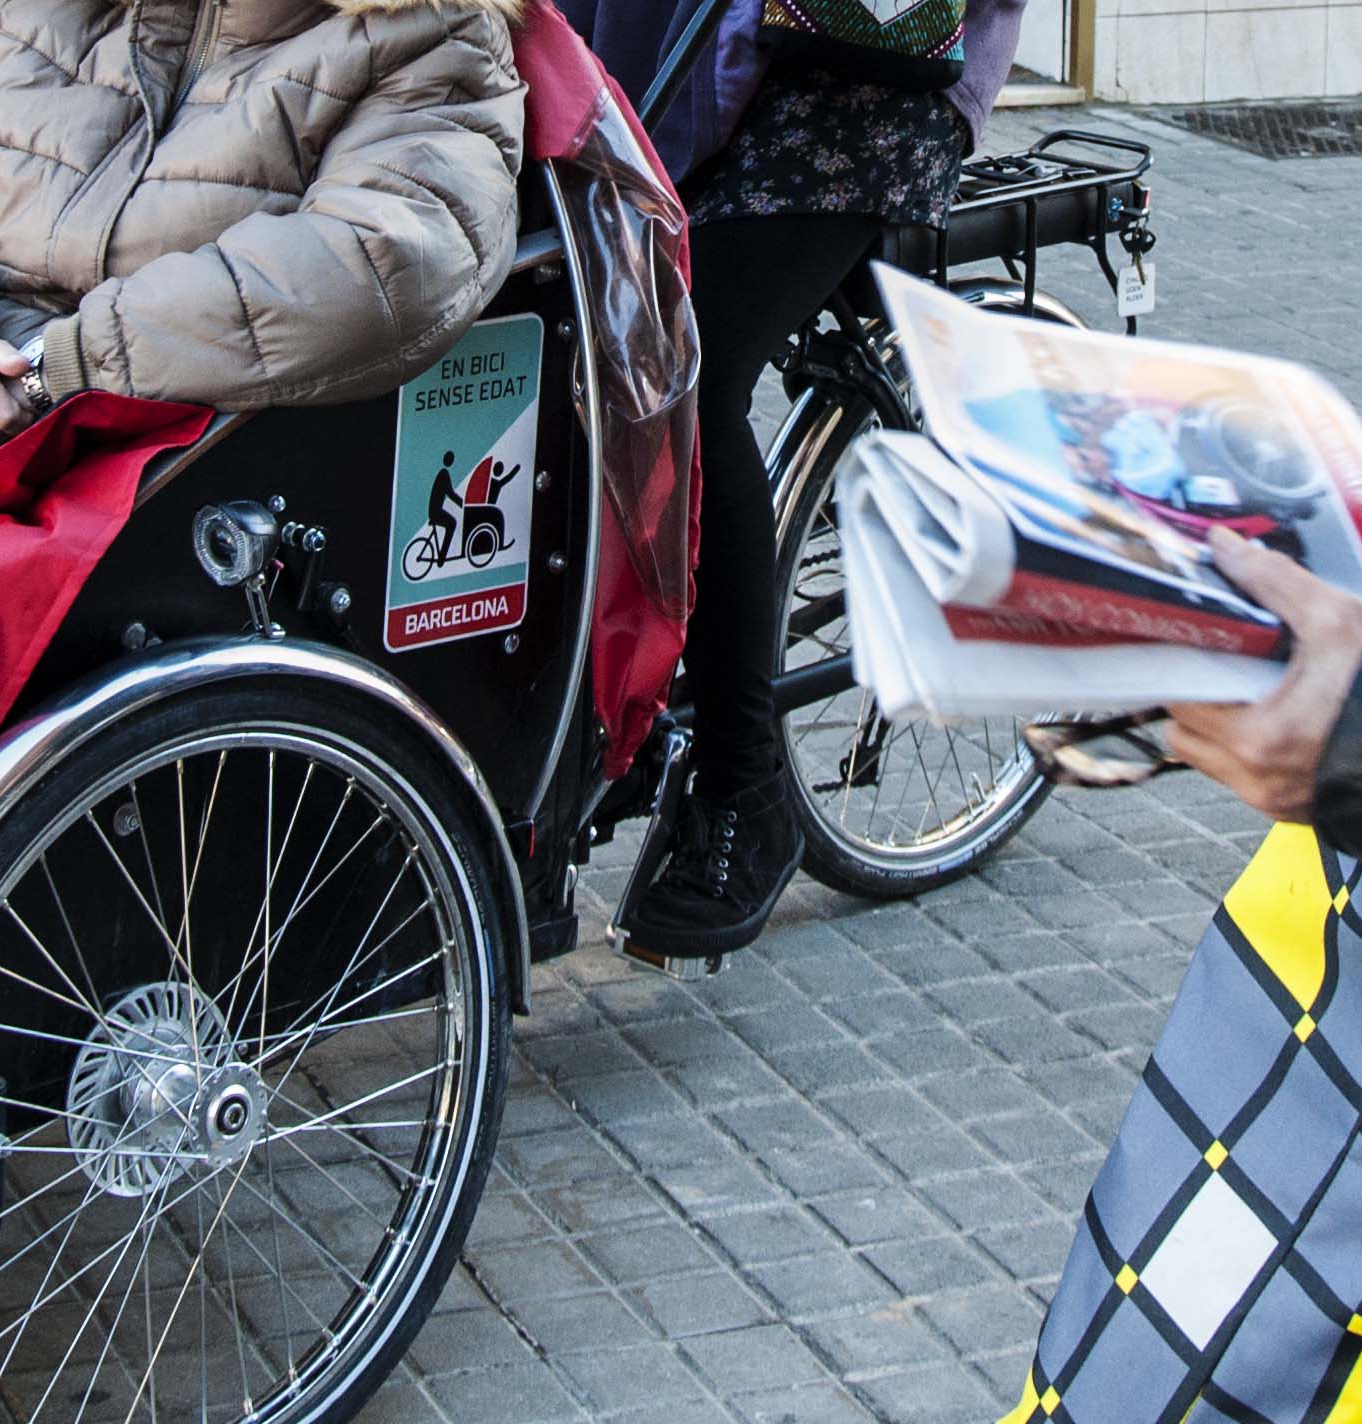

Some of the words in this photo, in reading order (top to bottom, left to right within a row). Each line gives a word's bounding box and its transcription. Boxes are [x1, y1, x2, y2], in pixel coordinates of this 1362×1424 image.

[441, 358, 465, 381] EN
[471, 351, 506, 375] BICI
[414, 382, 474, 412] SENSE
[479, 375, 528, 402] EDAT
[404, 594, 510, 637] BARCELONA
